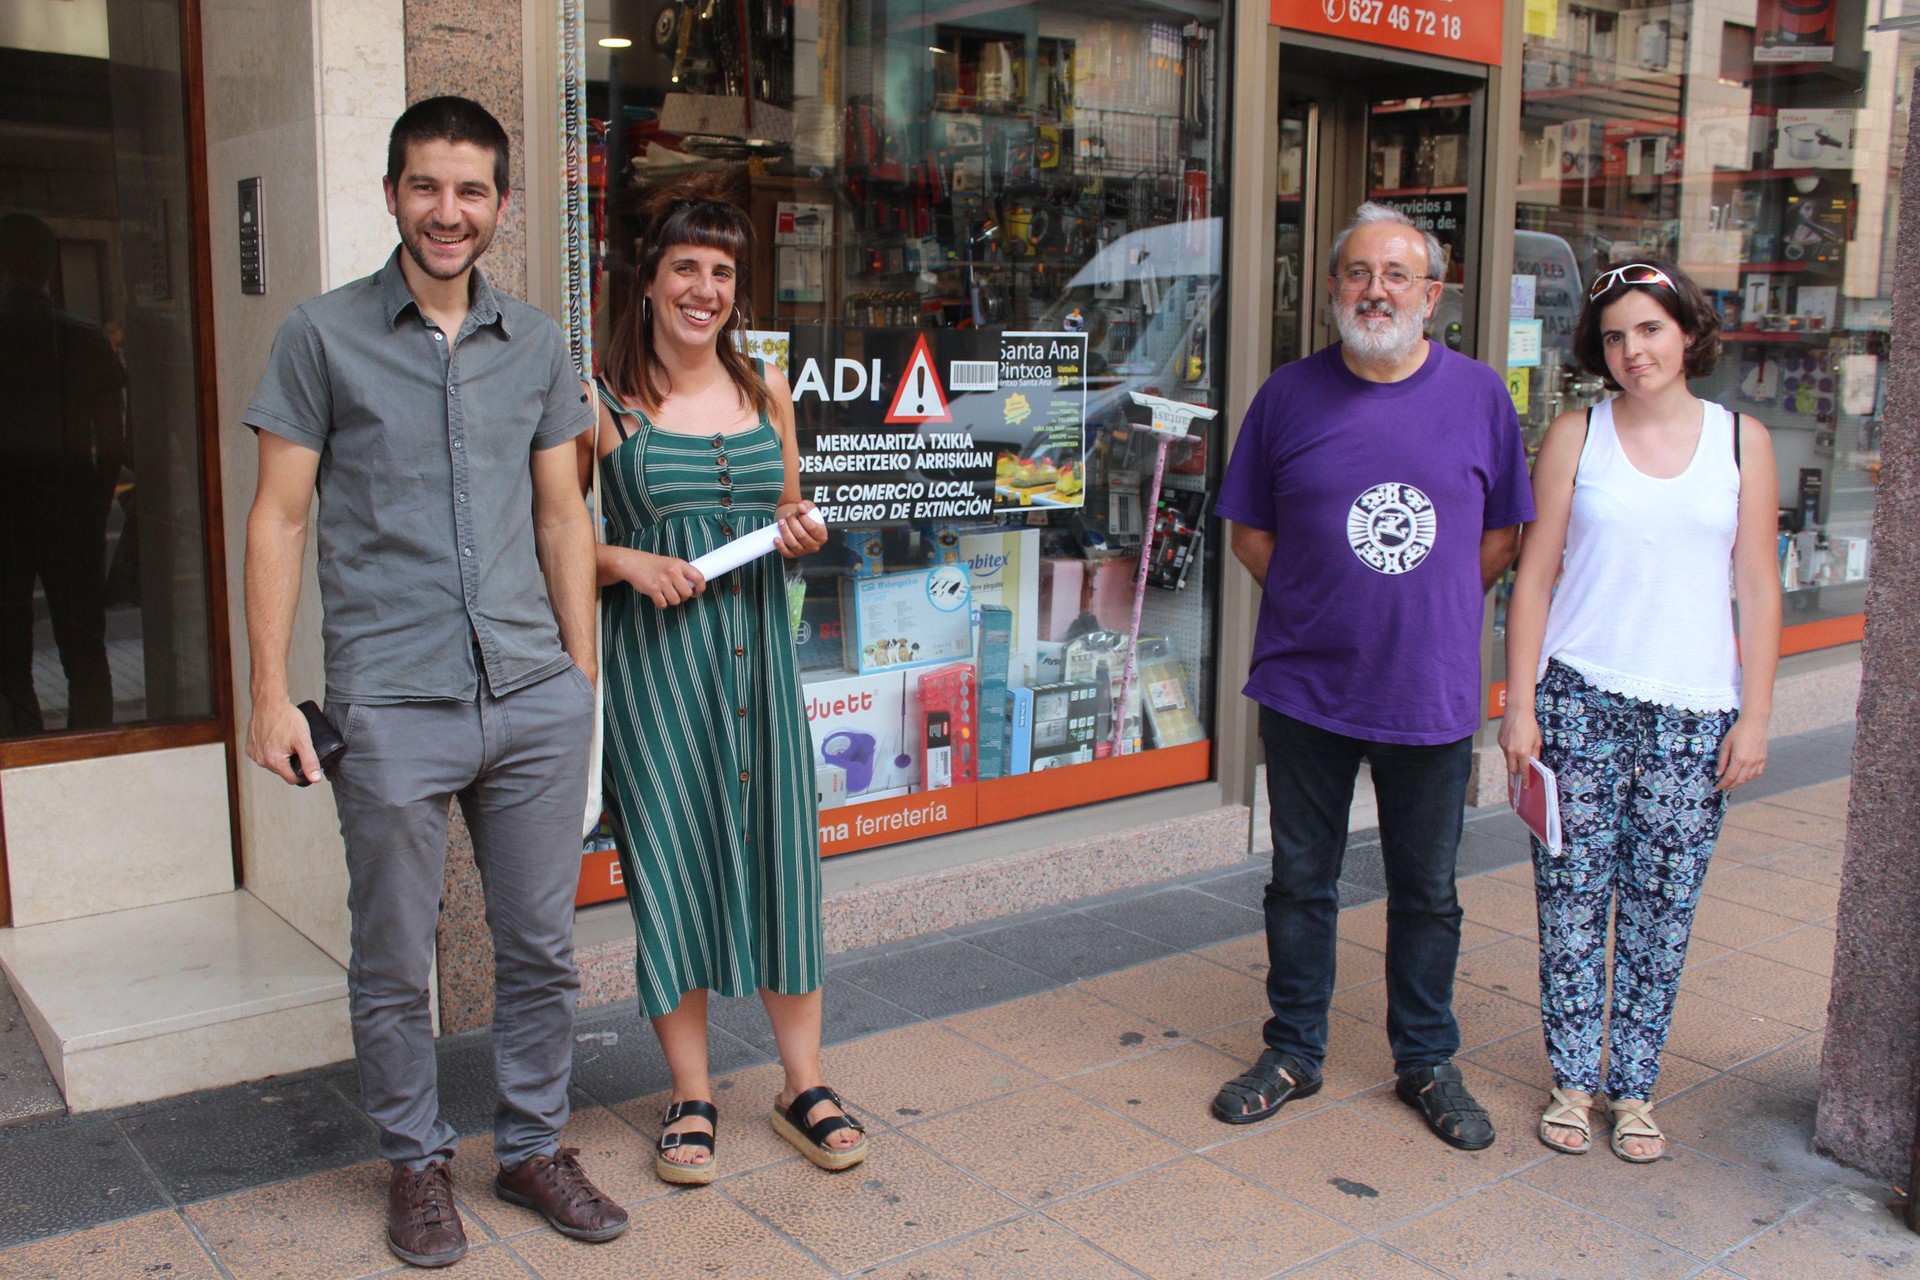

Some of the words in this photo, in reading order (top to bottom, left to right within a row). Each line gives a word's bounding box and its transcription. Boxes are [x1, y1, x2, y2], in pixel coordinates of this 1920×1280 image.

[1348, 0, 1384, 26] 627
[1387, 4, 1410, 31] 46
[1414, 9, 1436, 36] 72
[1441, 14, 1461, 40] 18
[1443, 201, 1452, 212] a
[1437, 215, 1456, 229] de:
[1048, 340, 1079, 360] Ana
[791, 357, 882, 402] ADI
[1000, 379, 1018, 387] intxo
[1152, 407, 1191, 426] antasy
[815, 434, 926, 452] MERKATARITZA
[929, 433, 974, 449] TXIKIA
[915, 452, 994, 470] ARRISKUAN
[813, 486, 830, 503] EL
[836, 483, 924, 502] COMERCIO
[928, 481, 975, 498] LOCAL
[820, 503, 886, 522] PELIGRO
[890, 502, 911, 520] DE
[914, 495, 992, 518] EXTINCIÓN
[968, 553, 1010, 571] abitex
[855, 801, 948, 838] ferretería
